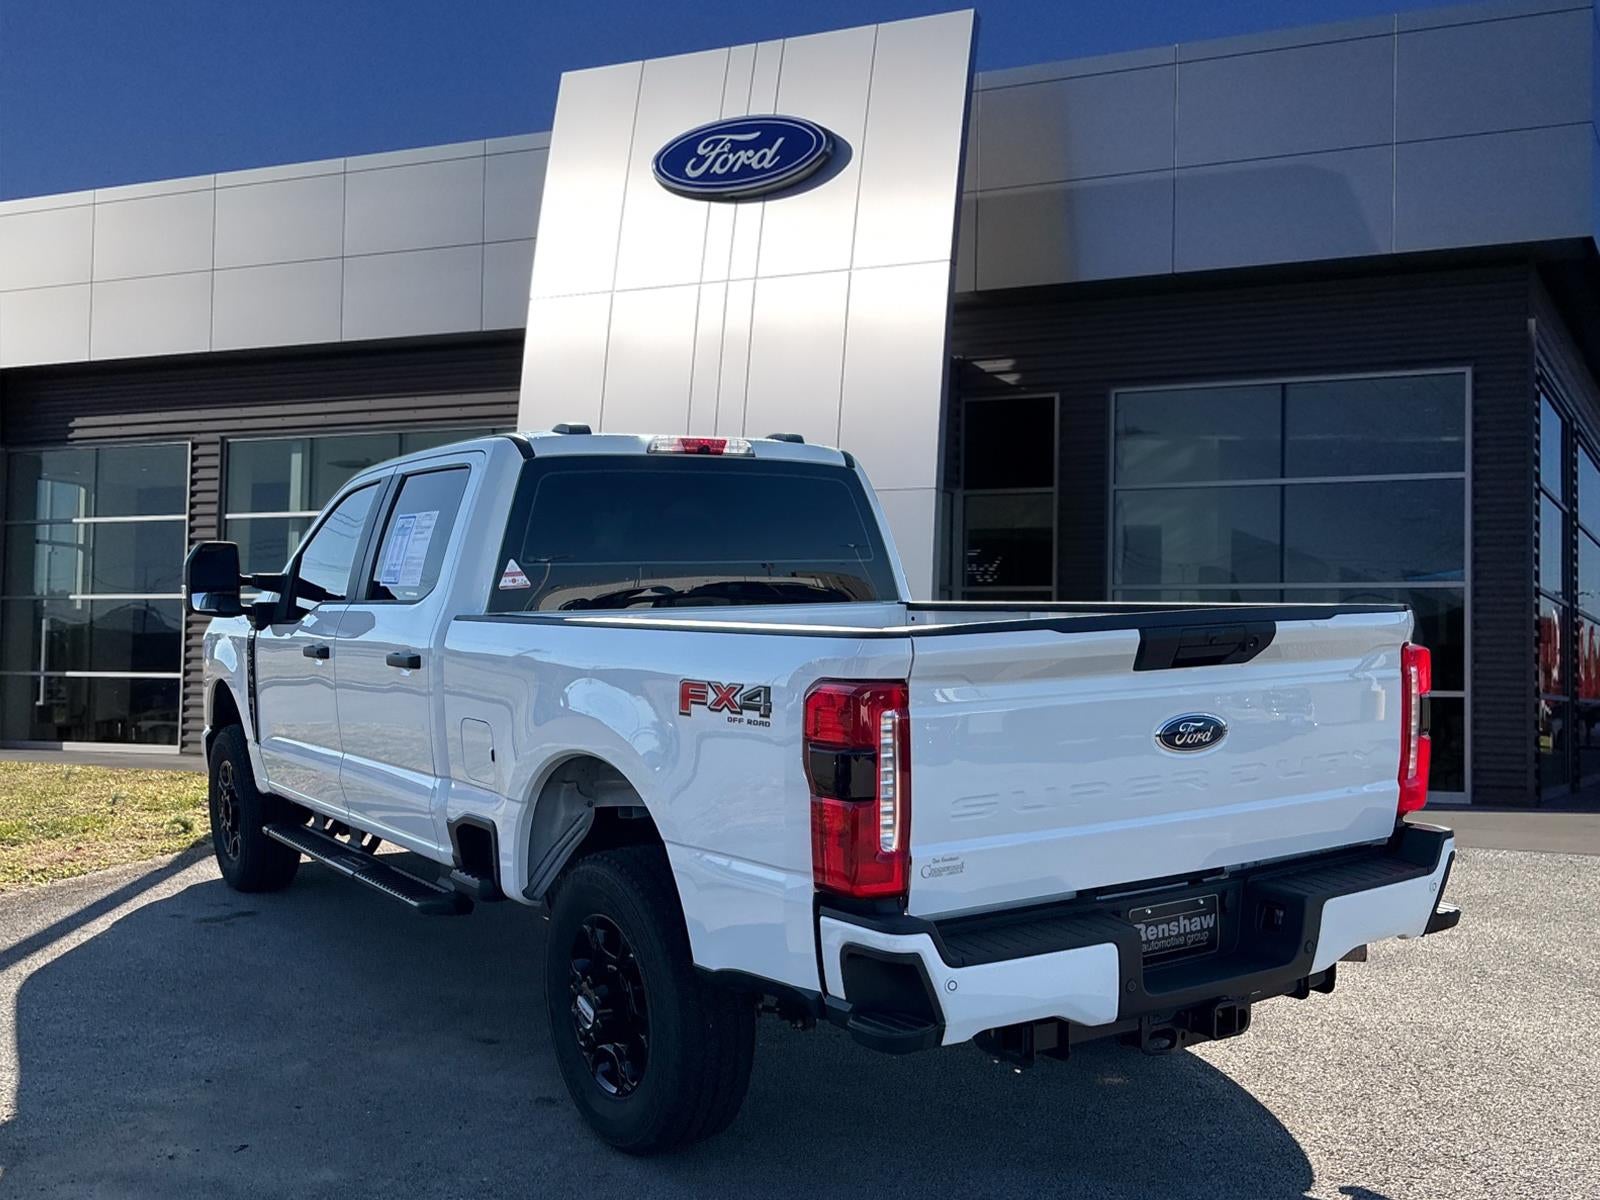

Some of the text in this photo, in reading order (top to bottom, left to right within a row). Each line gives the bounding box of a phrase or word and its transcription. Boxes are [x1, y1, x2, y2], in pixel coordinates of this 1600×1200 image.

[685, 131, 784, 178] Ford
[679, 678, 772, 718] FX4
[727, 716, 771, 728] OFF ROAD
[1175, 721, 1214, 745] Ford
[951, 747, 1382, 821] SUPER DUTY
[1134, 913, 1215, 941] Renshaw
[1142, 931, 1209, 952] automotive group
